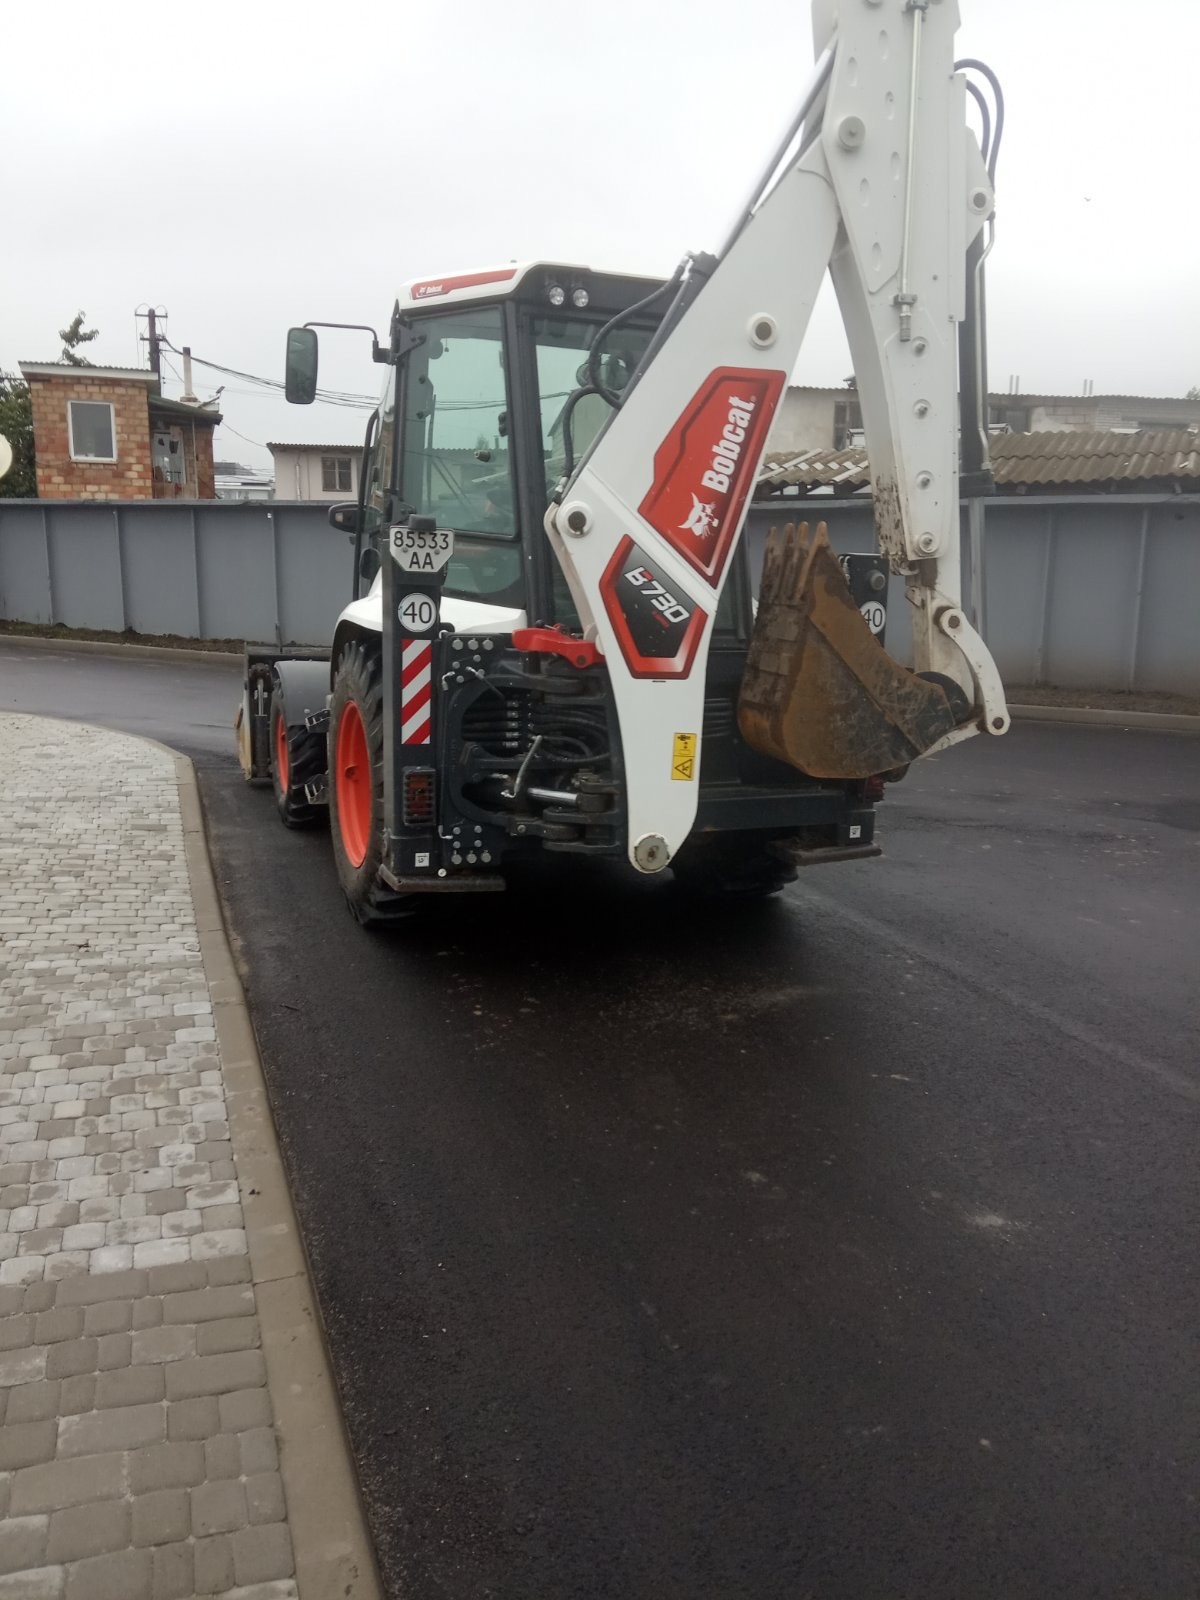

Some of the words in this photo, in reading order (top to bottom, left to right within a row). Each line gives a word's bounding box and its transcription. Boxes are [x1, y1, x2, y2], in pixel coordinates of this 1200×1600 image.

[701, 396, 755, 493] Bobcat
[393, 530, 449, 550] 85533
[409, 552, 434, 569] AA
[624, 566, 690, 623] B730
[403, 601, 433, 623] 40
[863, 608, 883, 627] 40
